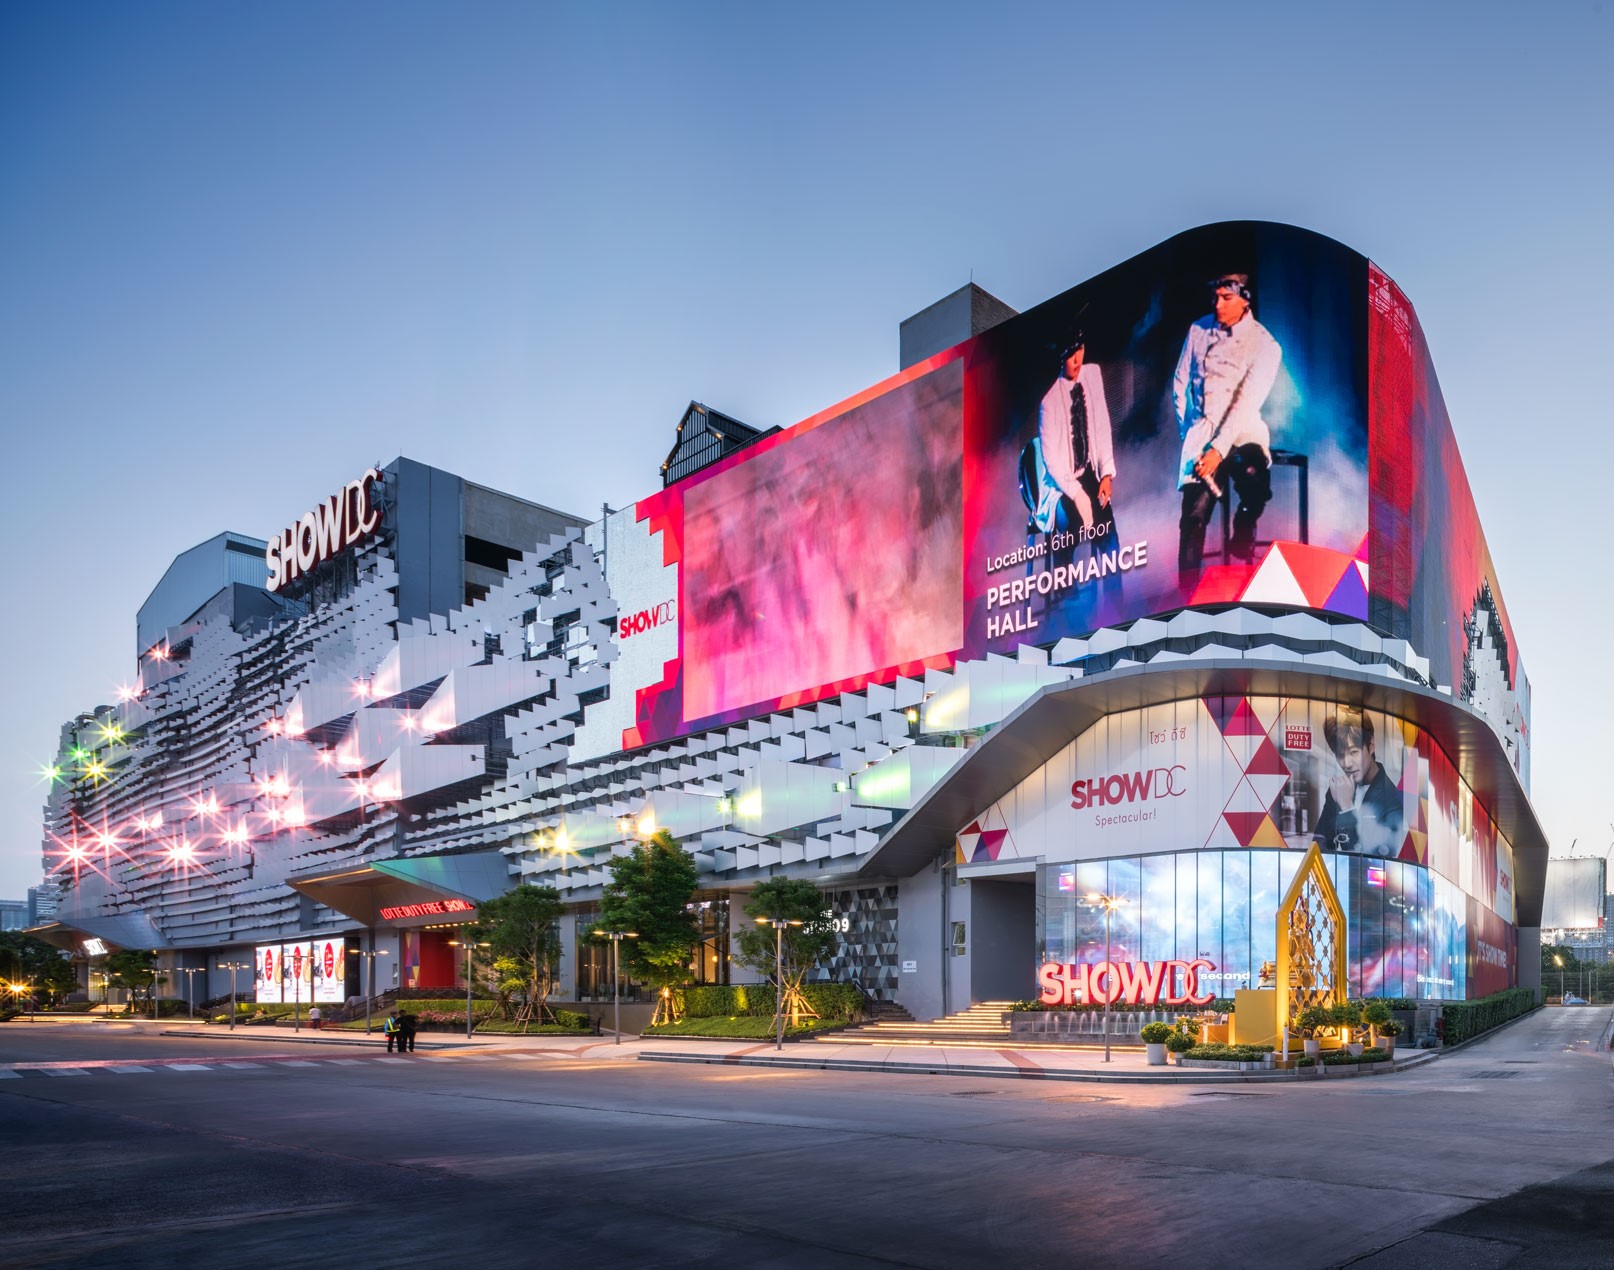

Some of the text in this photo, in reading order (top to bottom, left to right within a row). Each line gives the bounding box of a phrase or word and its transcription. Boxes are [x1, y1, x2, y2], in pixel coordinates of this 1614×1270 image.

[987, 520, 1112, 572] Location: 6th floor
[987, 540, 1148, 610] PERFORMANCE
[987, 607, 1039, 639] HALL
[1288, 733, 1310, 741] DUTY
[1095, 808, 1157, 829] Spectacular!
[380, 907, 405, 920] LOTTE
[401, 903, 422, 917] DUTY
[421, 901, 446, 914] FREE
[1201, 971, 1250, 981] second
